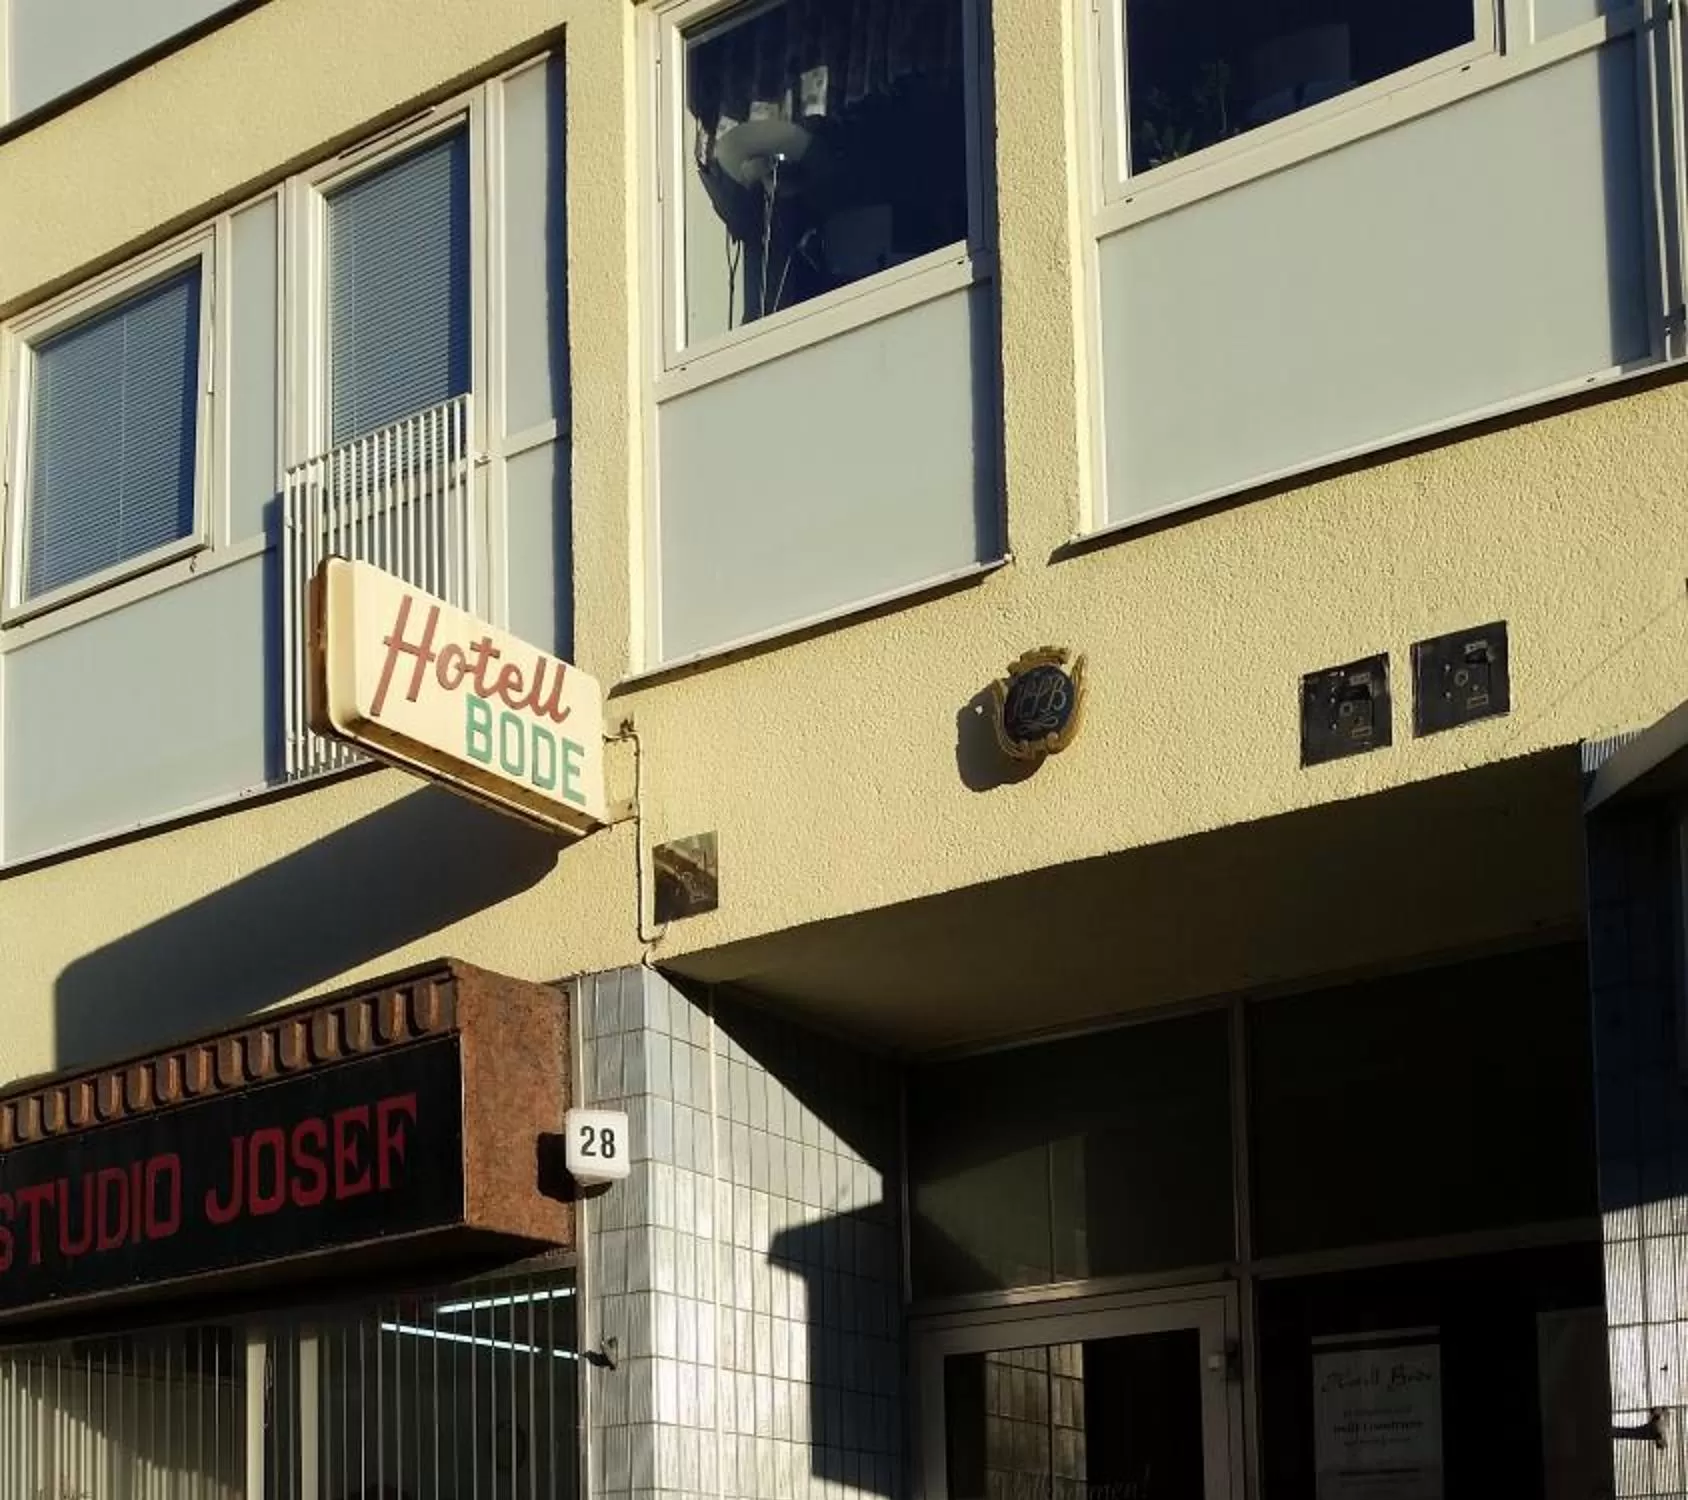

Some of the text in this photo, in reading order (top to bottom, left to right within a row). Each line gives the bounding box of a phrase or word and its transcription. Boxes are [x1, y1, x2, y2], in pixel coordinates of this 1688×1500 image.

[368, 593, 572, 724] Hotell
[464, 691, 587, 806] BODE
[205, 1093, 418, 1224] JOSEF
[580, 1125, 616, 1159] 28
